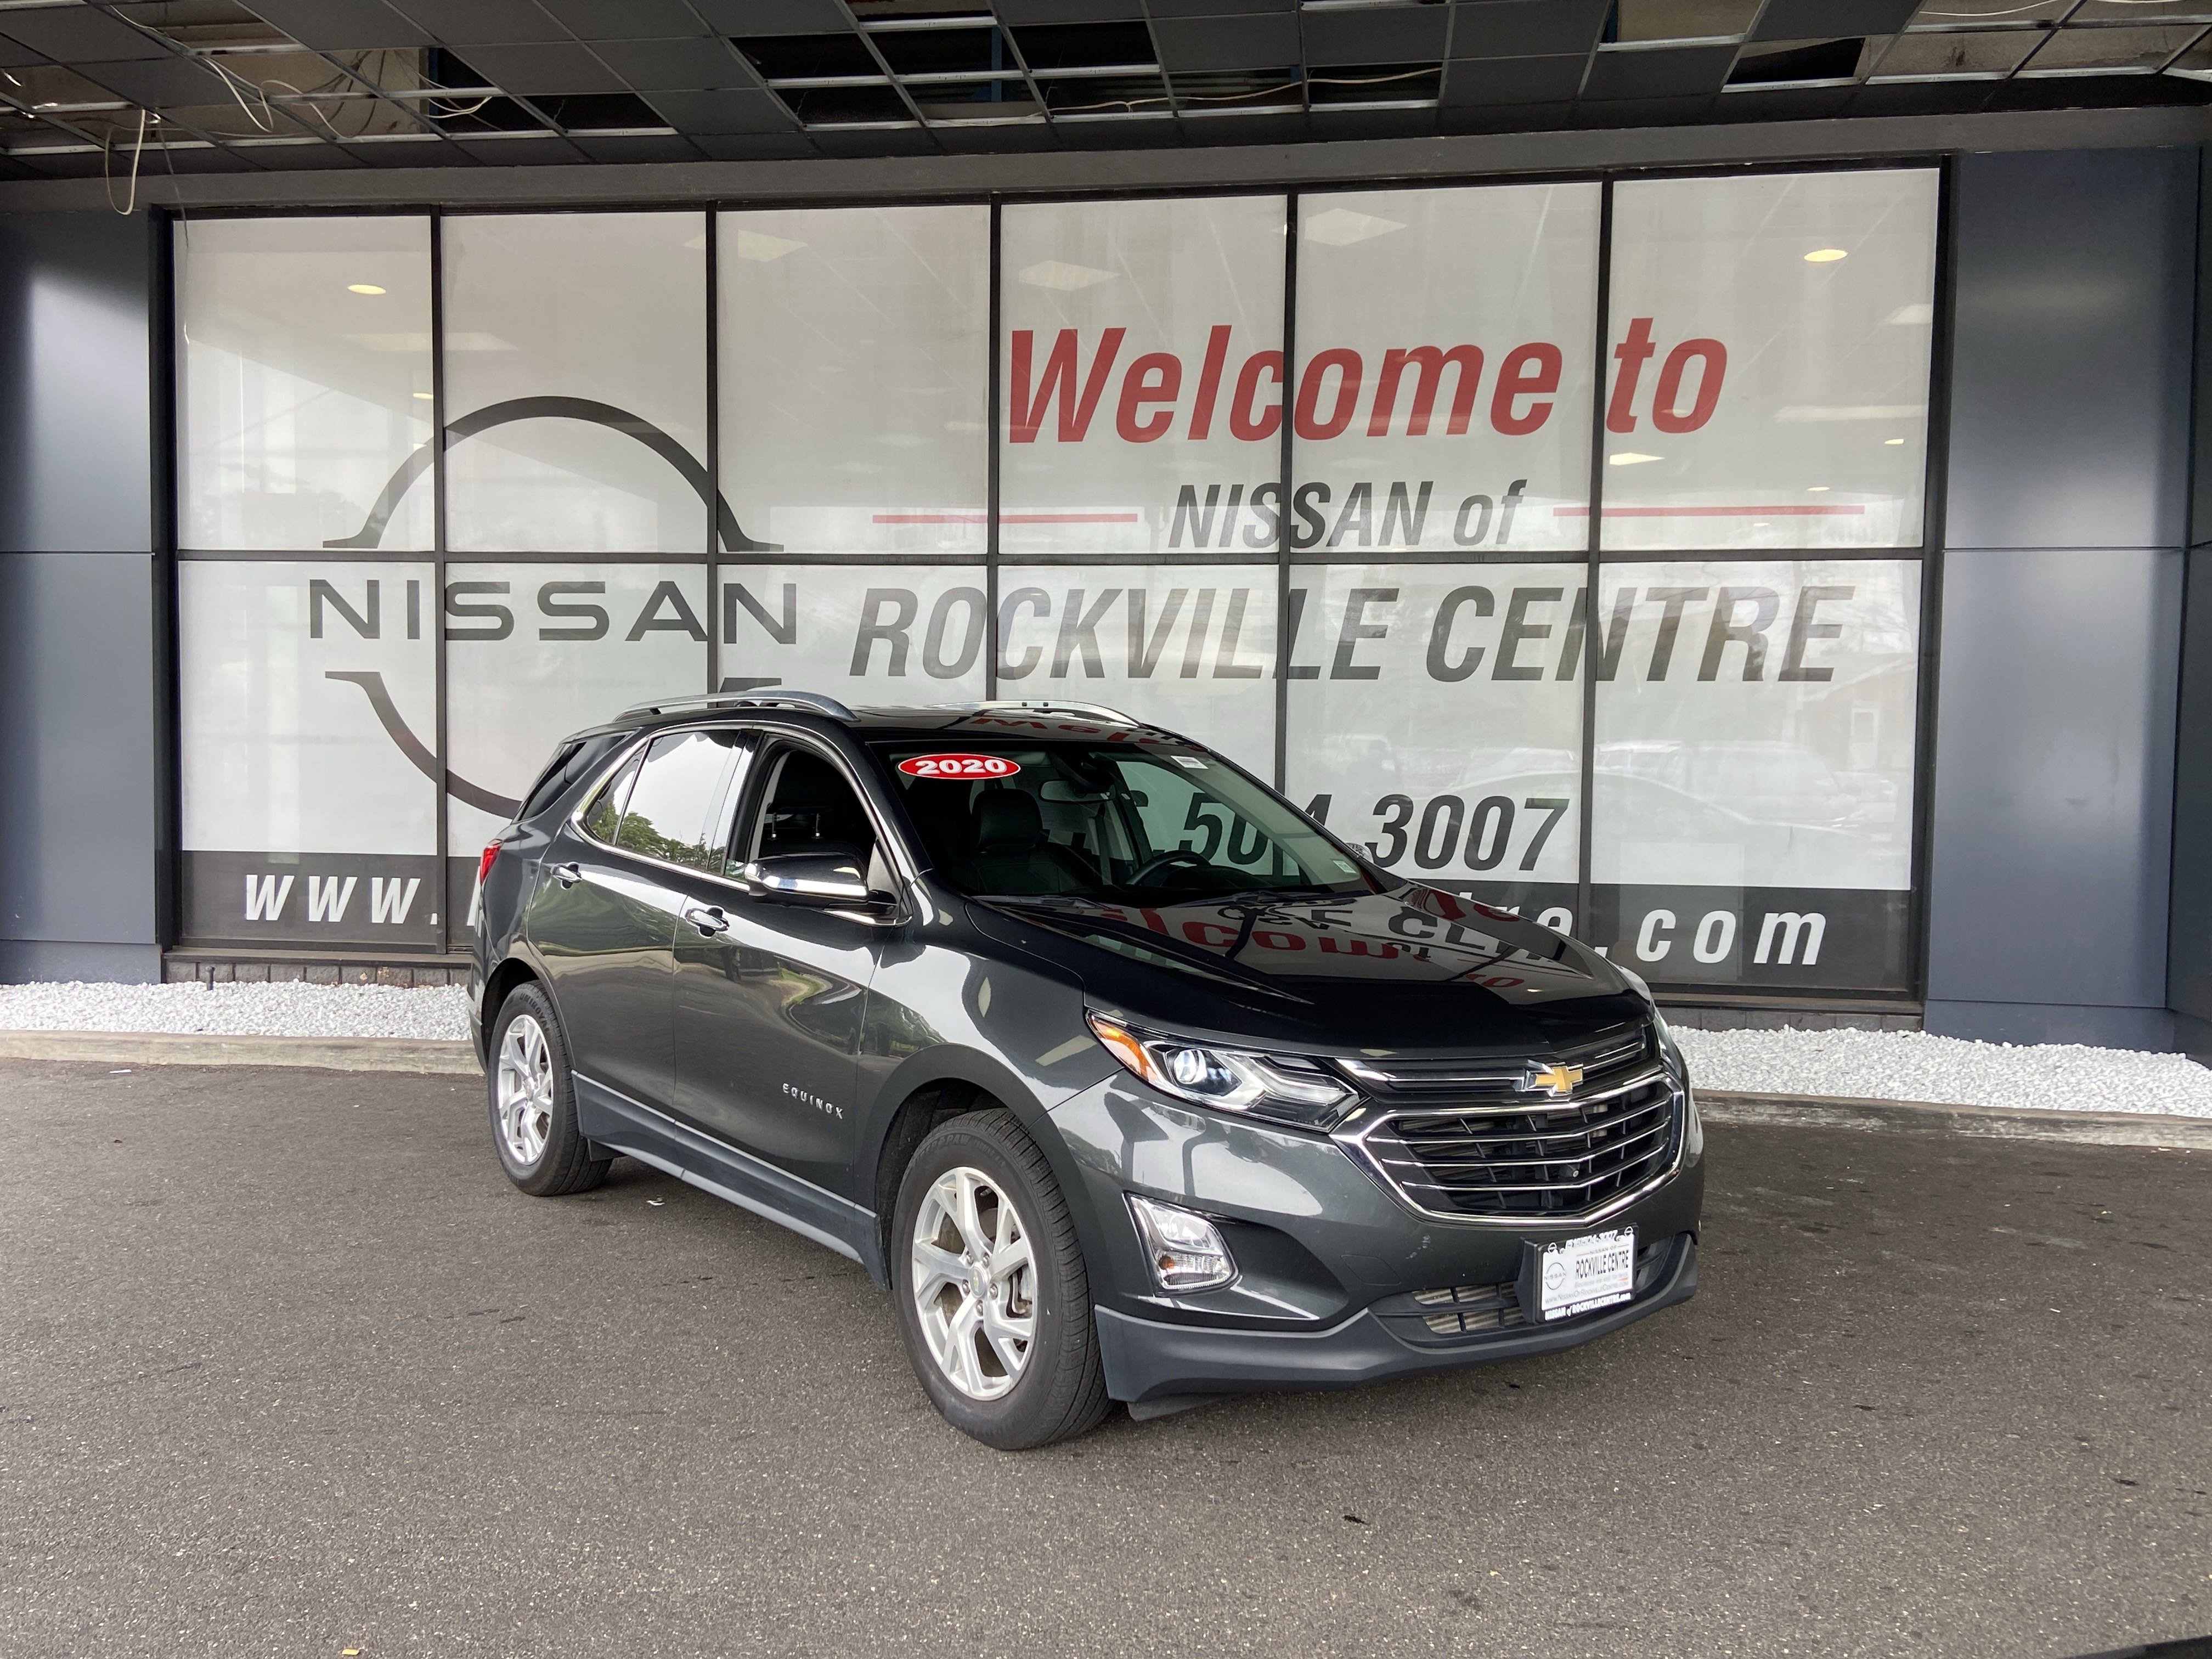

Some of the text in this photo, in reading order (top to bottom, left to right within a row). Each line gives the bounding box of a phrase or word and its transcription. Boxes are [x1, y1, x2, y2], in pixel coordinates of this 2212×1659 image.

[1009, 318, 1727, 443] Welcome to
[1169, 479, 1526, 548] NISSAN of
[309, 579, 796, 645] NISSAN
[849, 584, 1855, 683] ROCKVILLE CENTRE
[915, 759, 1007, 775] 2020
[782, 1083, 843, 1119] EQUINOX
[1544, 1271, 1567, 1280] NISSAN
[1575, 1254, 1606, 1279] ROCKVILLE
[1608, 1250, 1629, 1273] CENTRE
[1544, 1307, 1566, 1321] NISSAN
[1567, 1305, 1573, 1317] of
